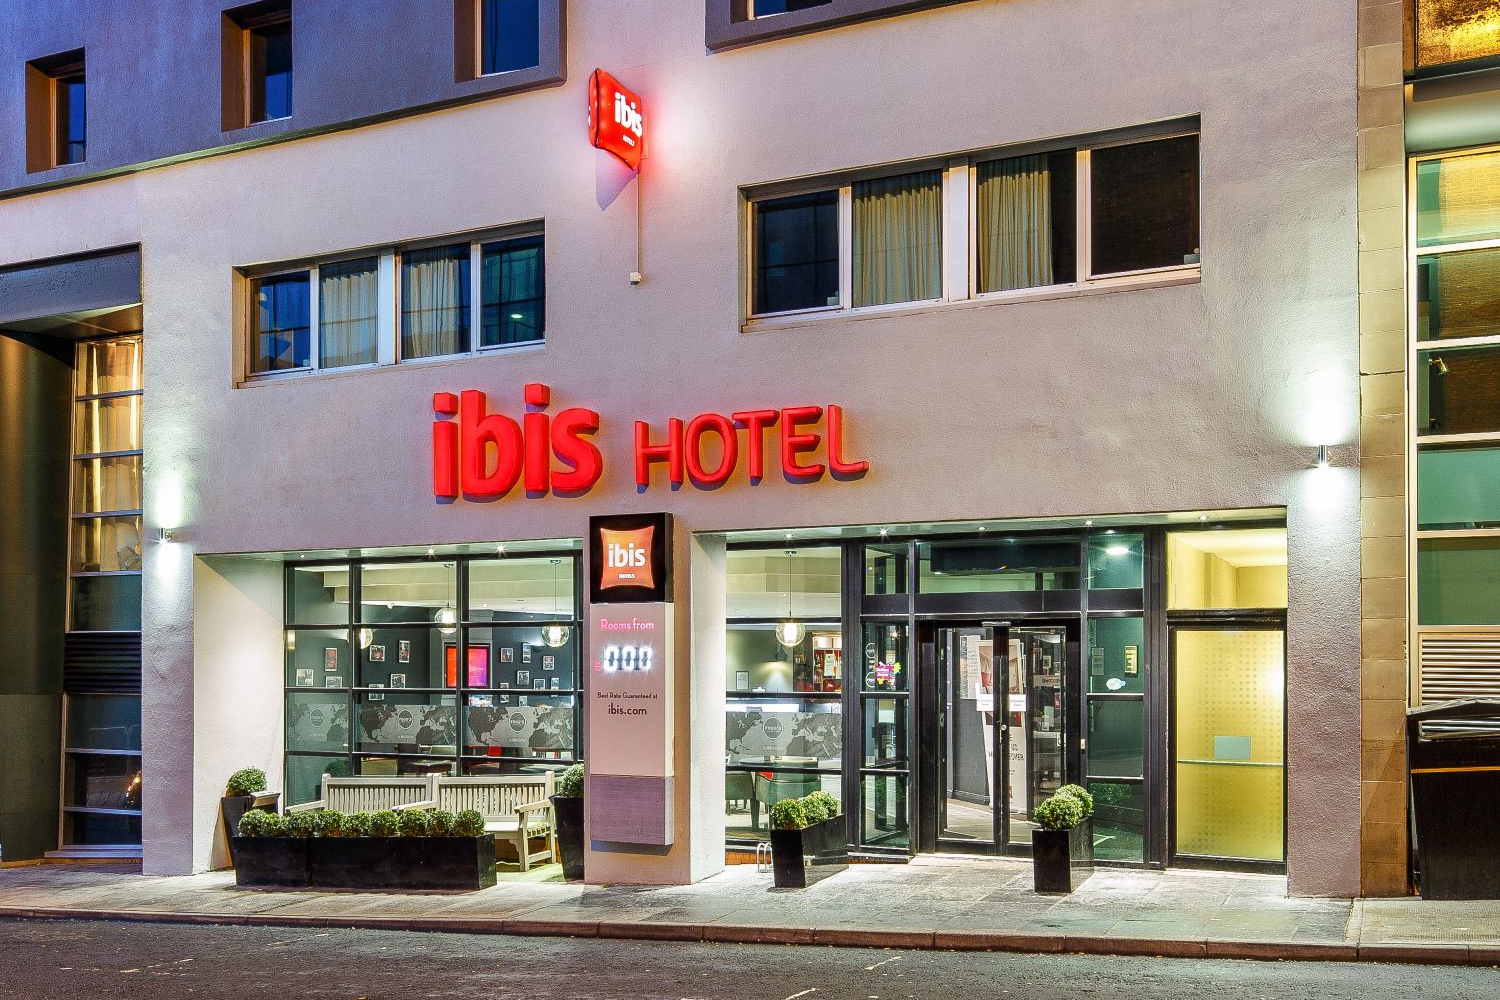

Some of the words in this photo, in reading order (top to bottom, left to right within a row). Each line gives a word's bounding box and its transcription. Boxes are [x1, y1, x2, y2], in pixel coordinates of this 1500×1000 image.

[614, 91, 642, 138] ibis
[433, 383, 603, 499] ibis
[634, 404, 869, 488] HOTEL
[608, 542, 646, 568] ibis
[600, 618, 631, 631] Rooms
[632, 617, 654, 630] from
[597, 691, 609, 699] Best
[609, 691, 622, 699] Rate
[622, 691, 652, 699] Guaranteed
[608, 702, 647, 715] ibis.com
